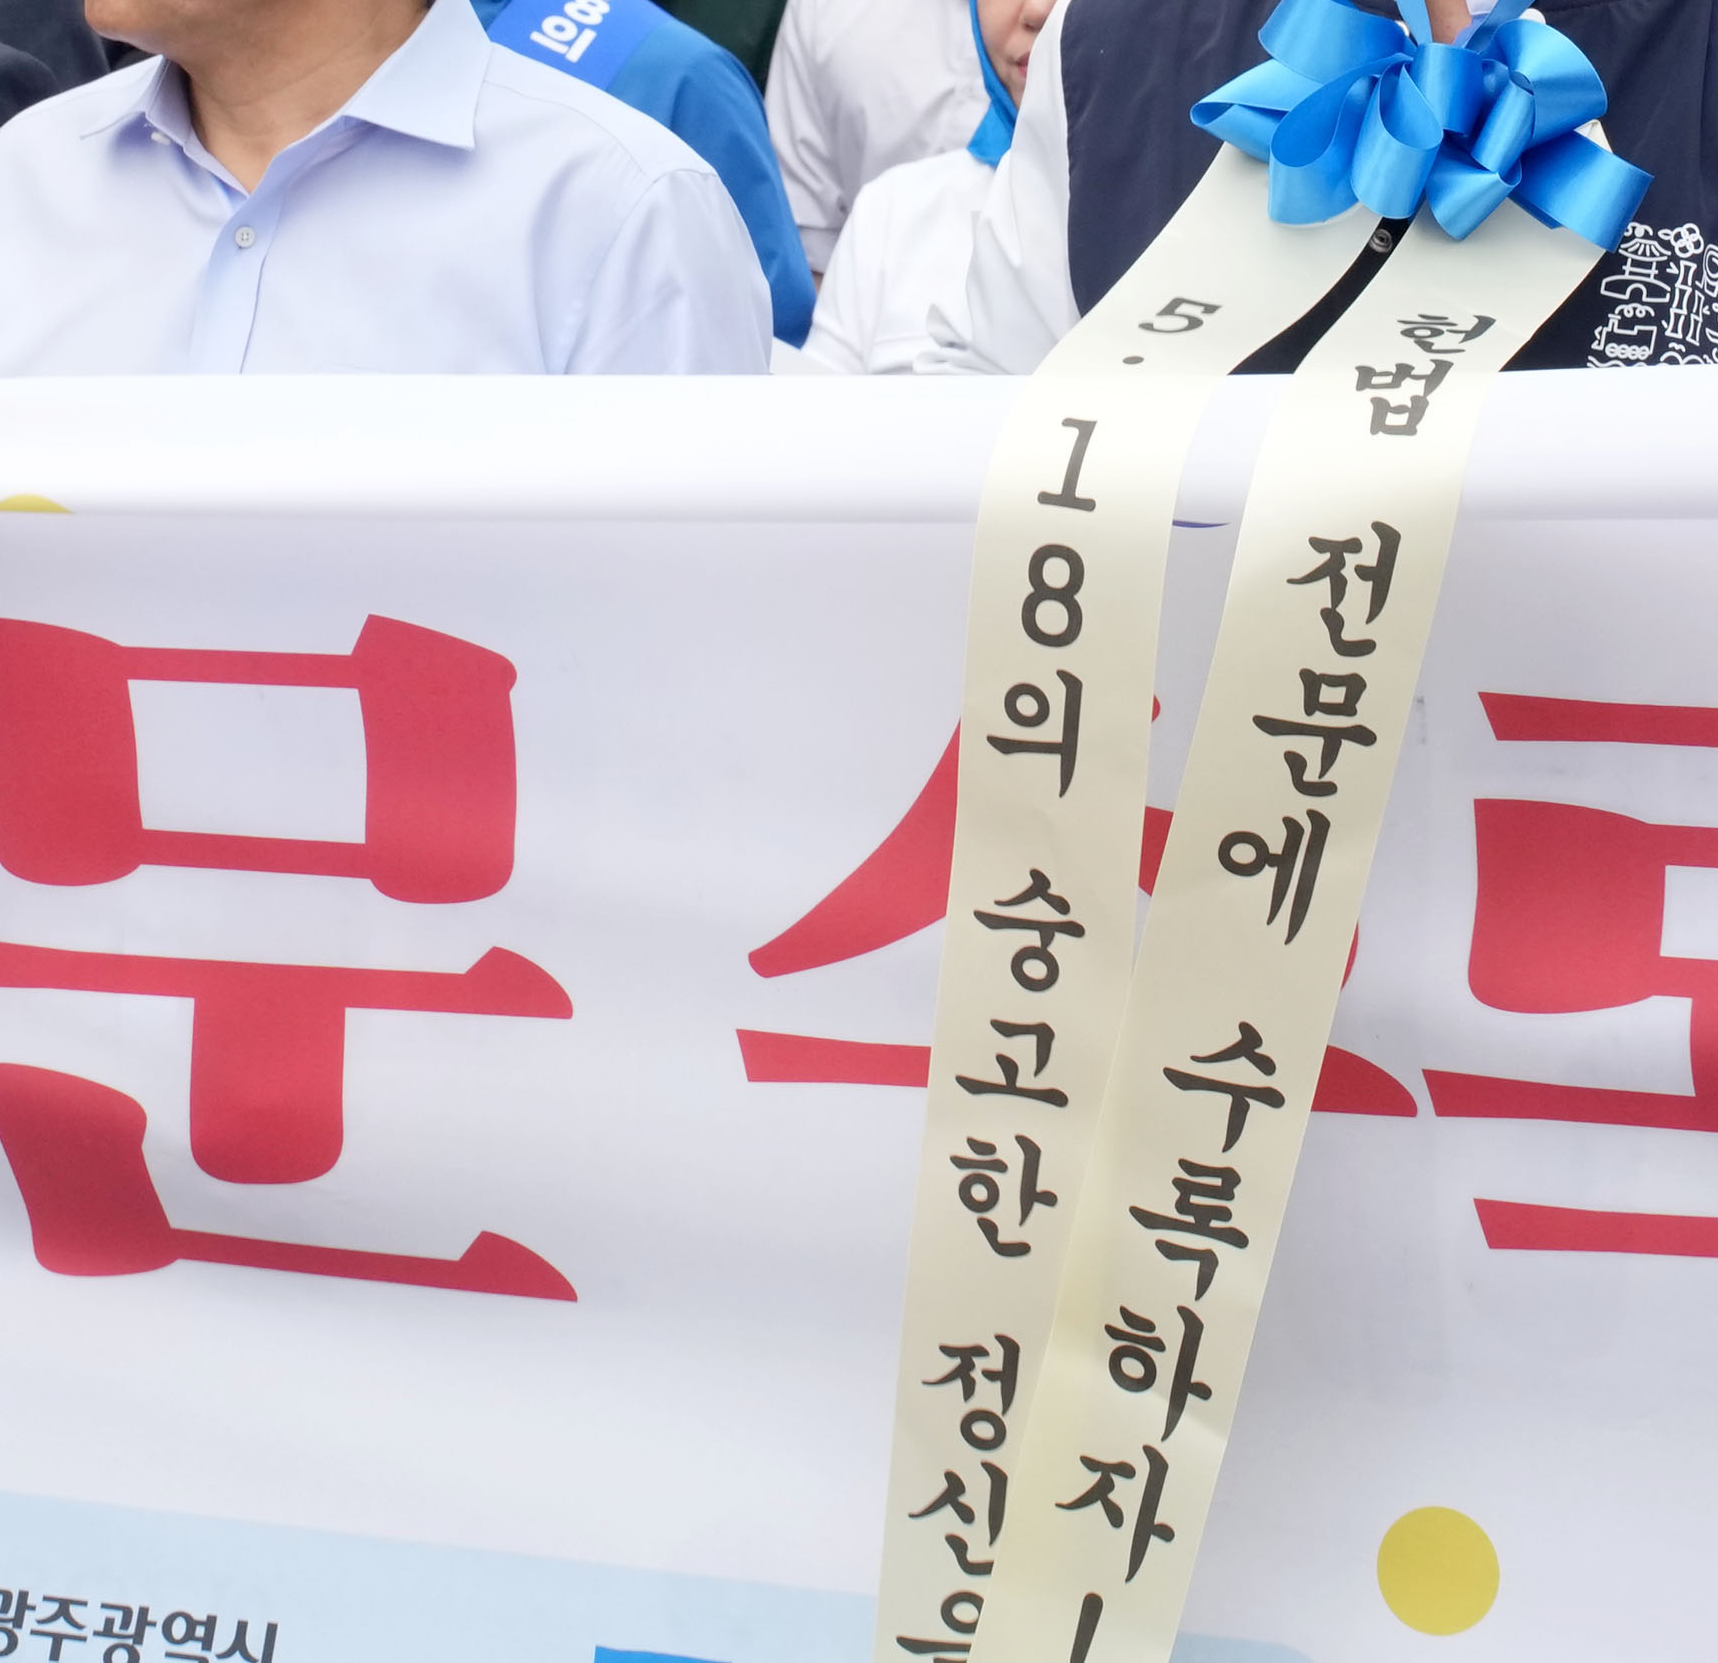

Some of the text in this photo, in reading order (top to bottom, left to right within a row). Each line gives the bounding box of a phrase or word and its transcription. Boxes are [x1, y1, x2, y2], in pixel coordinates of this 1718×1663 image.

[1354, 313, 1496, 437] 헌법
[1219, 520, 1401, 946] 전문에
[949, 868, 1087, 1258] 숭고한
